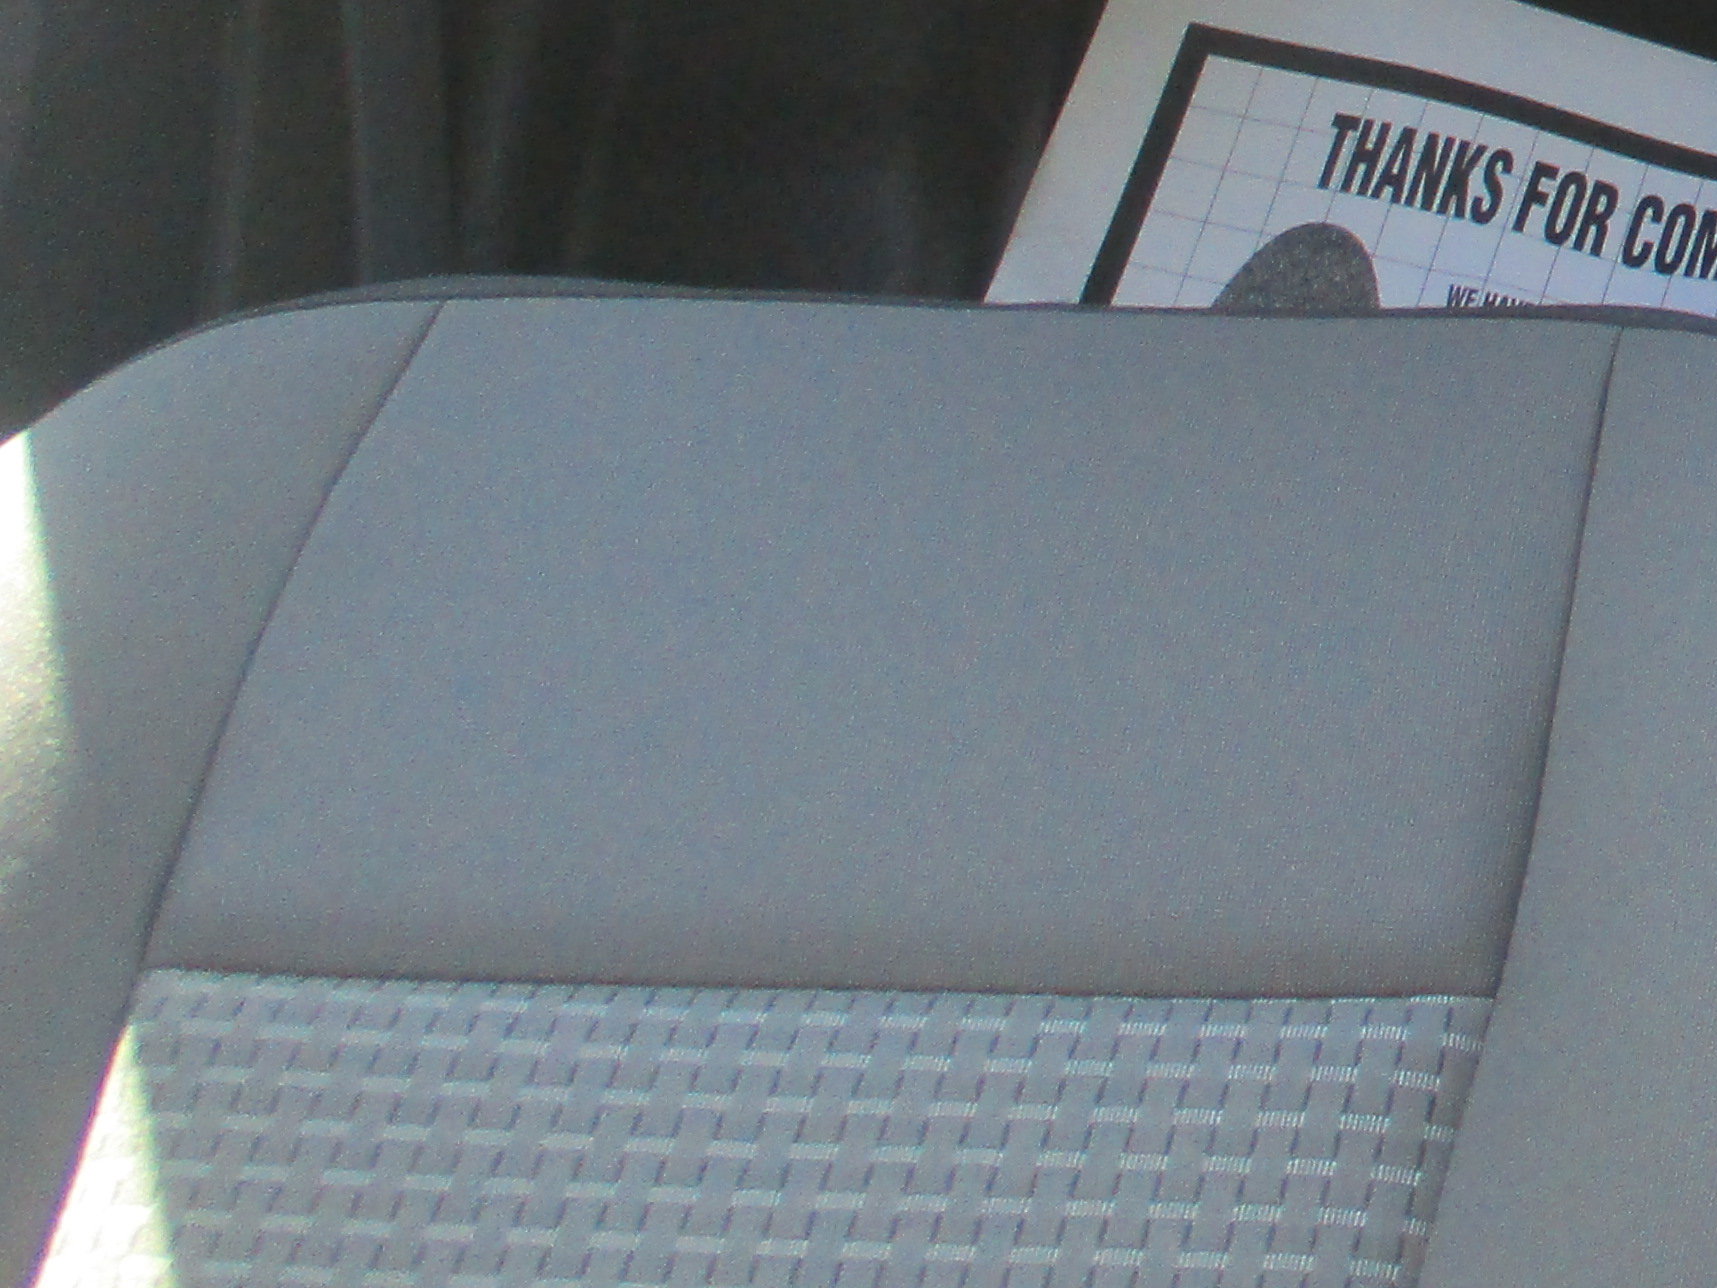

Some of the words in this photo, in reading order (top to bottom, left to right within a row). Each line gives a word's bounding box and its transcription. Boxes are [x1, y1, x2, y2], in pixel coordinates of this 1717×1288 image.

[1317, 113, 1513, 225] THANKS
[1511, 161, 1618, 258] FOR
[1446, 282, 1480, 308] WE
